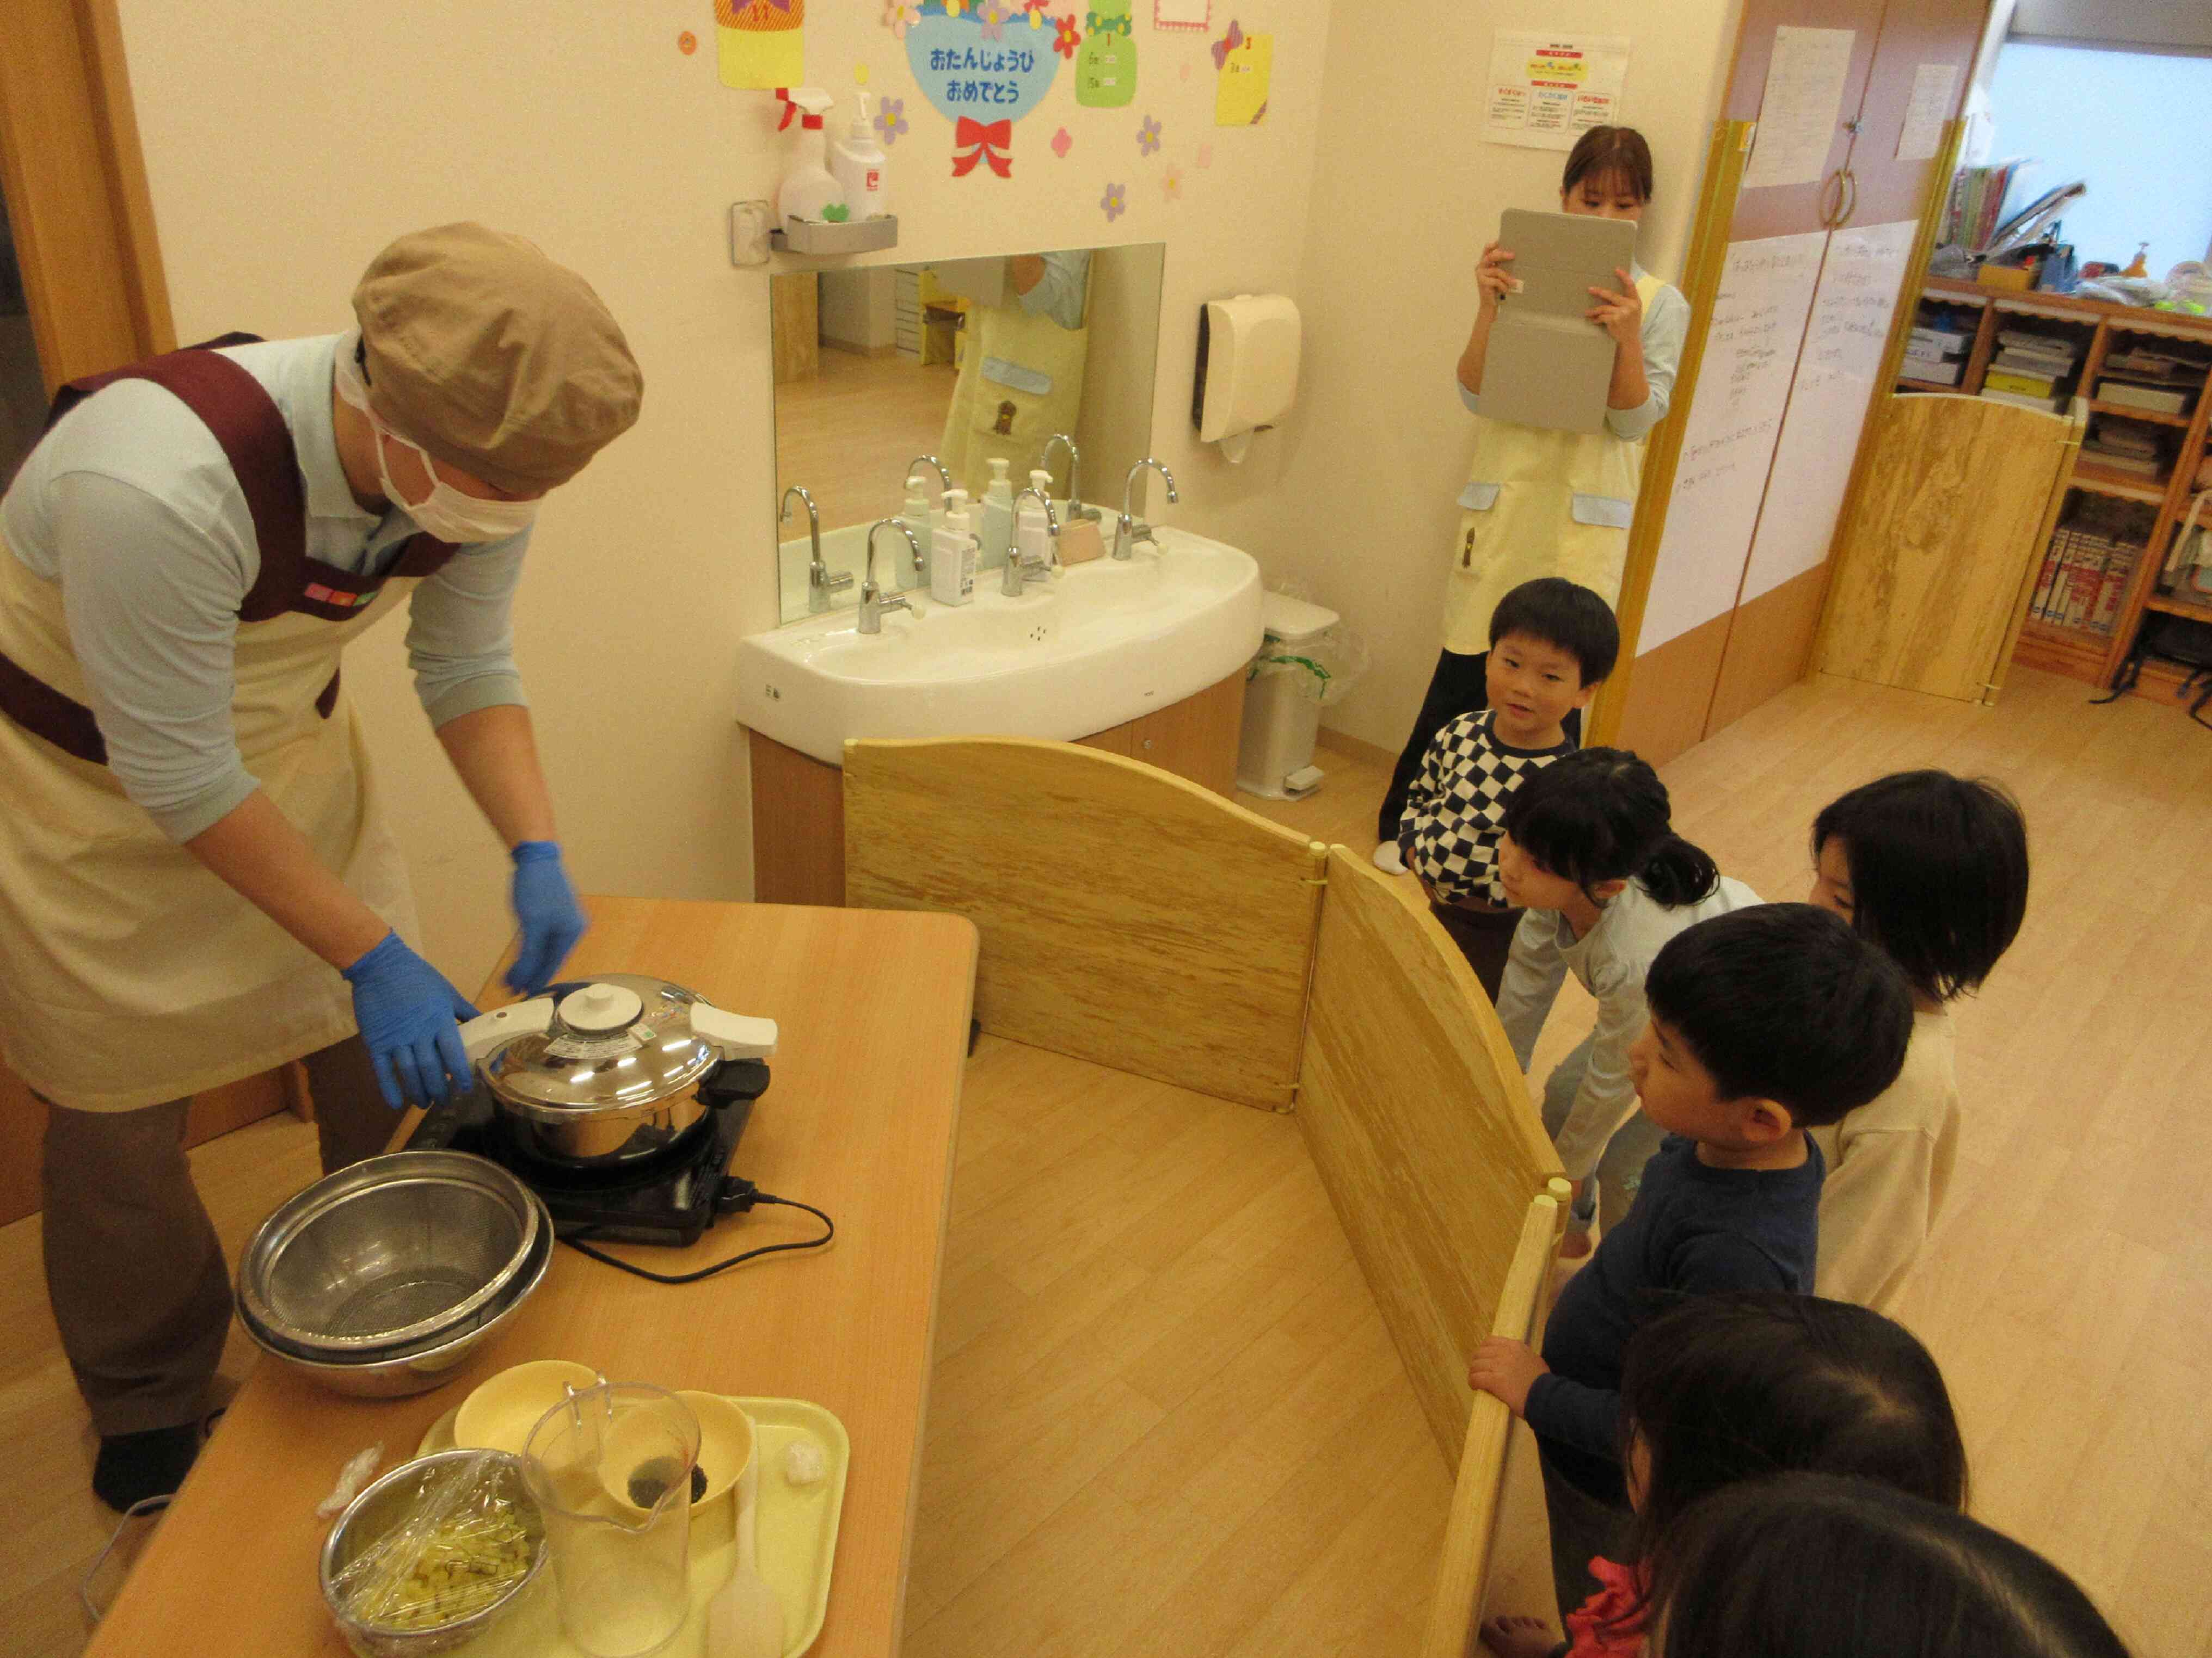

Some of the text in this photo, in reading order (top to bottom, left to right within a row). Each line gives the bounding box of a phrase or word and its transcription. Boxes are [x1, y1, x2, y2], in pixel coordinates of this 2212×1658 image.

[946, 80, 1019, 103] おめでとう
